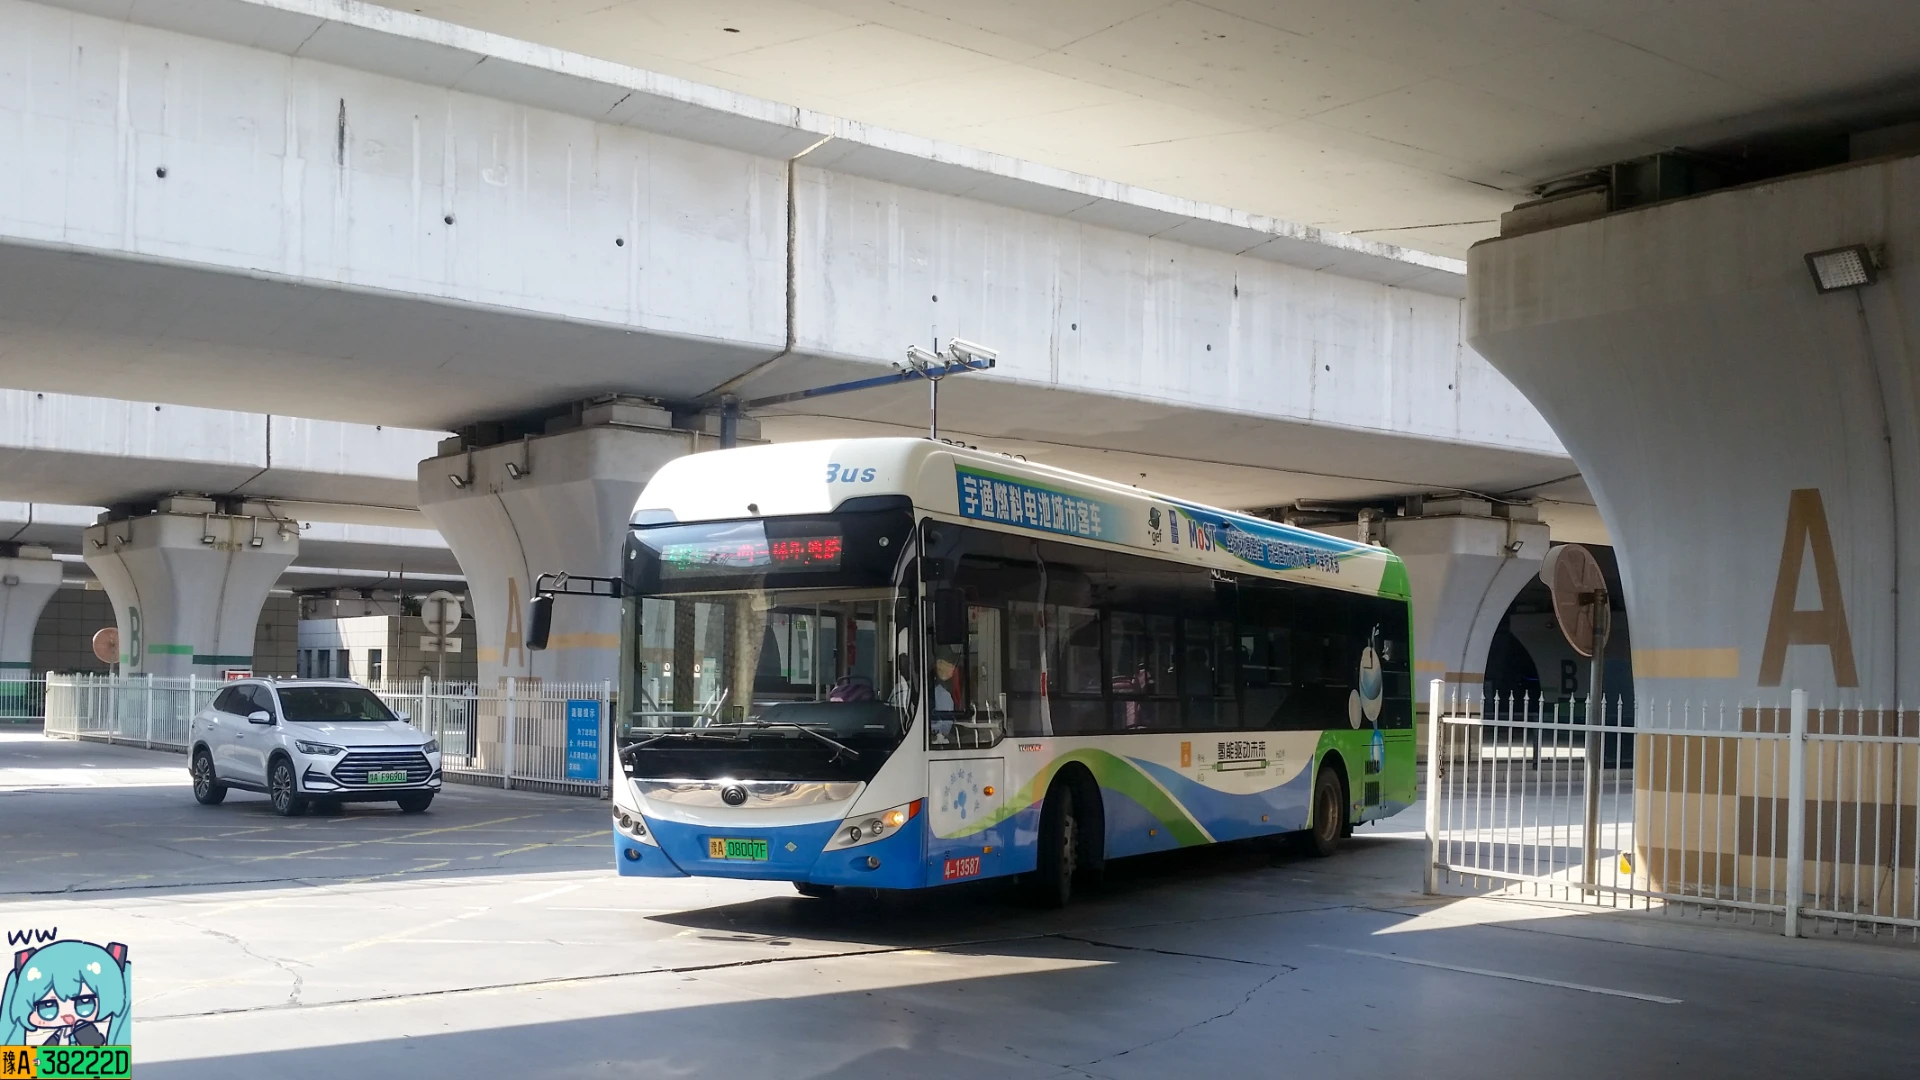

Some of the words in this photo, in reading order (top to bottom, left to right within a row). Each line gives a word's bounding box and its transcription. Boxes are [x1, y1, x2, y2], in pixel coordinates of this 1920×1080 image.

[826, 463, 877, 483] Bus
[963, 476, 1102, 537] 宇通燃料电池城市客车
[1758, 488, 1859, 688] A
[128, 606, 141, 668] B
[503, 577, 525, 668] A
[1560, 659, 1579, 695] B
[1217, 741, 1266, 760] 氢能驱动未来
[944, 857, 980, 879] 4-13587
